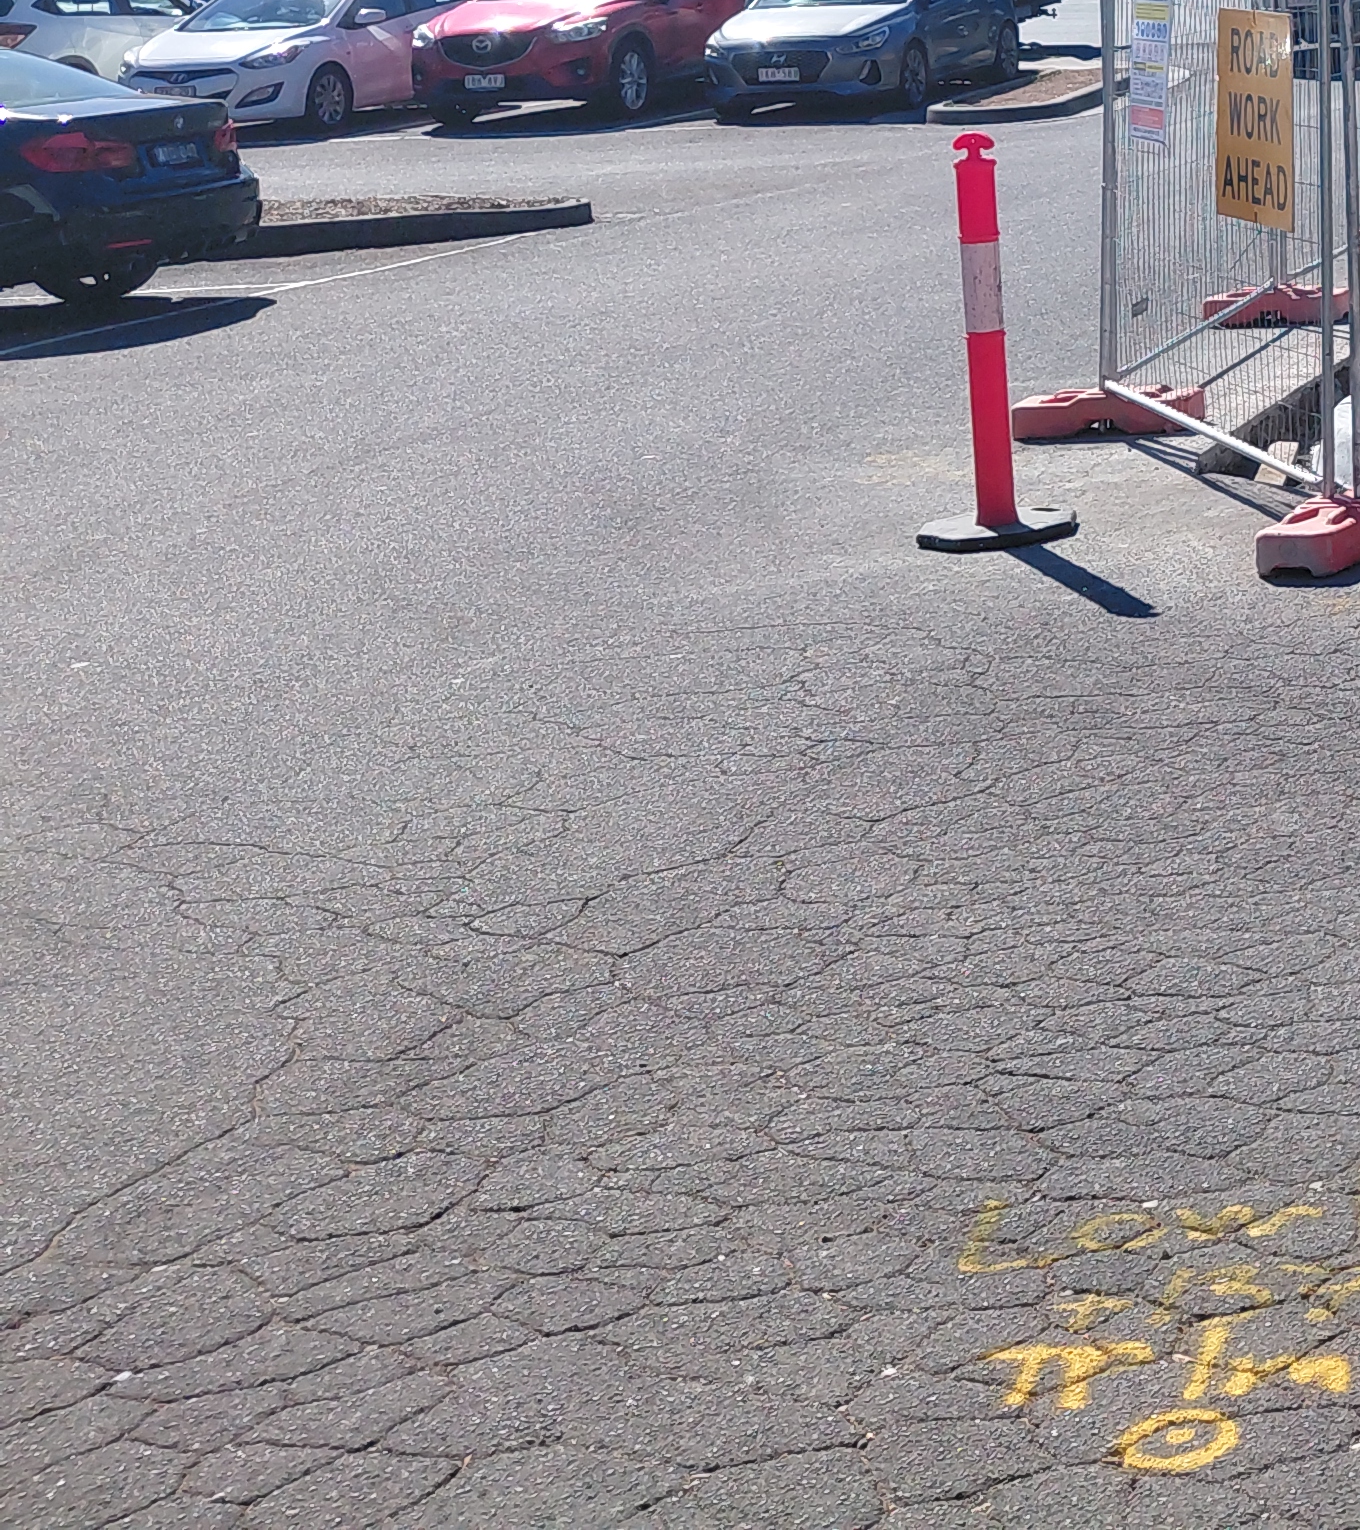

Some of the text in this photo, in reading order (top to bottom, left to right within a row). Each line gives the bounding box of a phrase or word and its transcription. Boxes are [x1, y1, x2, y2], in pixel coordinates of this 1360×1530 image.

[1230, 27, 1280, 78] ROAD
[1228, 91, 1282, 145] WORK
[1221, 154, 1289, 211] AHEAD
